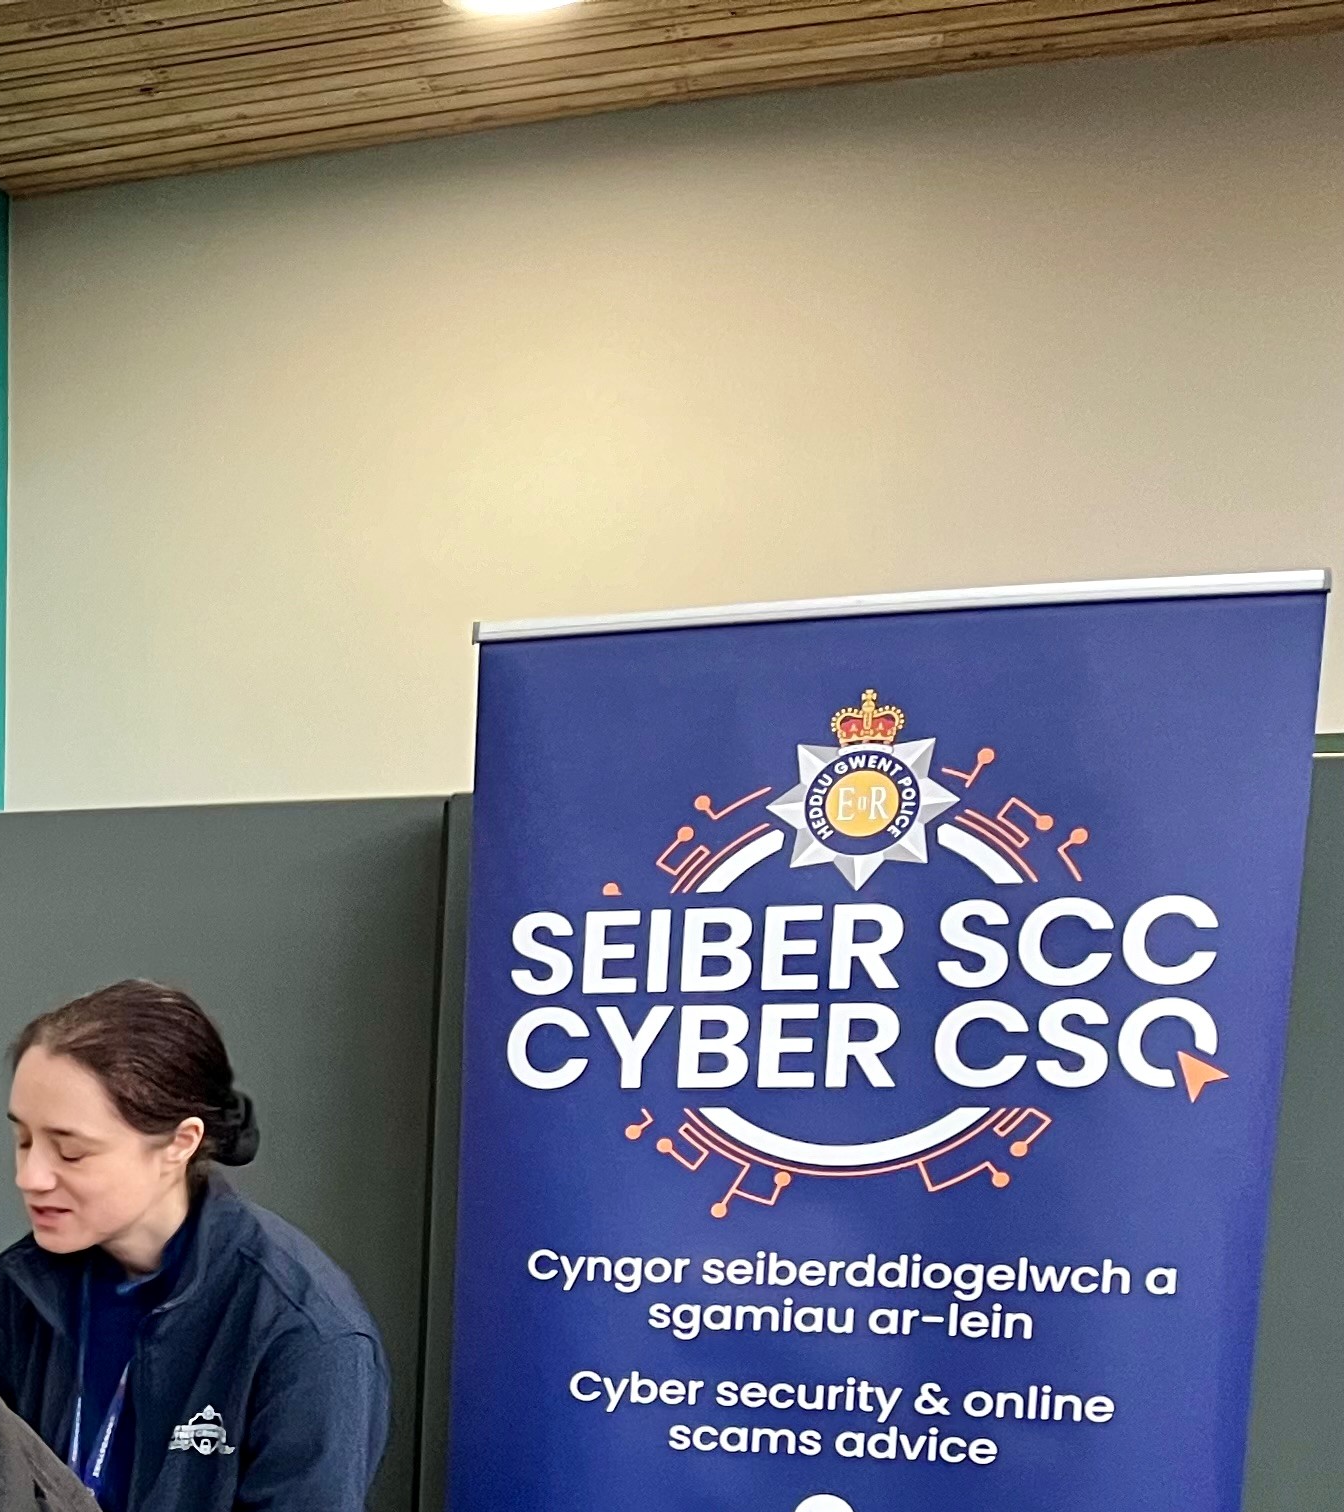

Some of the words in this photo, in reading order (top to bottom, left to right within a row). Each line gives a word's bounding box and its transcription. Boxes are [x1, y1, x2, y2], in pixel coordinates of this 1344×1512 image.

[809, 773, 834, 840] HEDDLU
[834, 755, 903, 777] GWENT
[887, 776, 916, 838] POLICE
[510, 902, 904, 996] SEIBER
[937, 894, 1219, 988] SCC
[506, 1001, 900, 1091] CYBER
[527, 1248, 691, 1292] Cyngor
[701, 1251, 1131, 1302] seiberddiogelwch
[1145, 1265, 1178, 1295] a
[648, 1297, 855, 1340] sgamiau
[868, 1303, 1034, 1340] ar-lein
[569, 1370, 705, 1412] Cyber
[715, 1376, 904, 1424] security
[913, 1382, 951, 1416] &
[963, 1384, 1115, 1423] online
[668, 1422, 822, 1457] scams
[834, 1426, 999, 1465] advice
